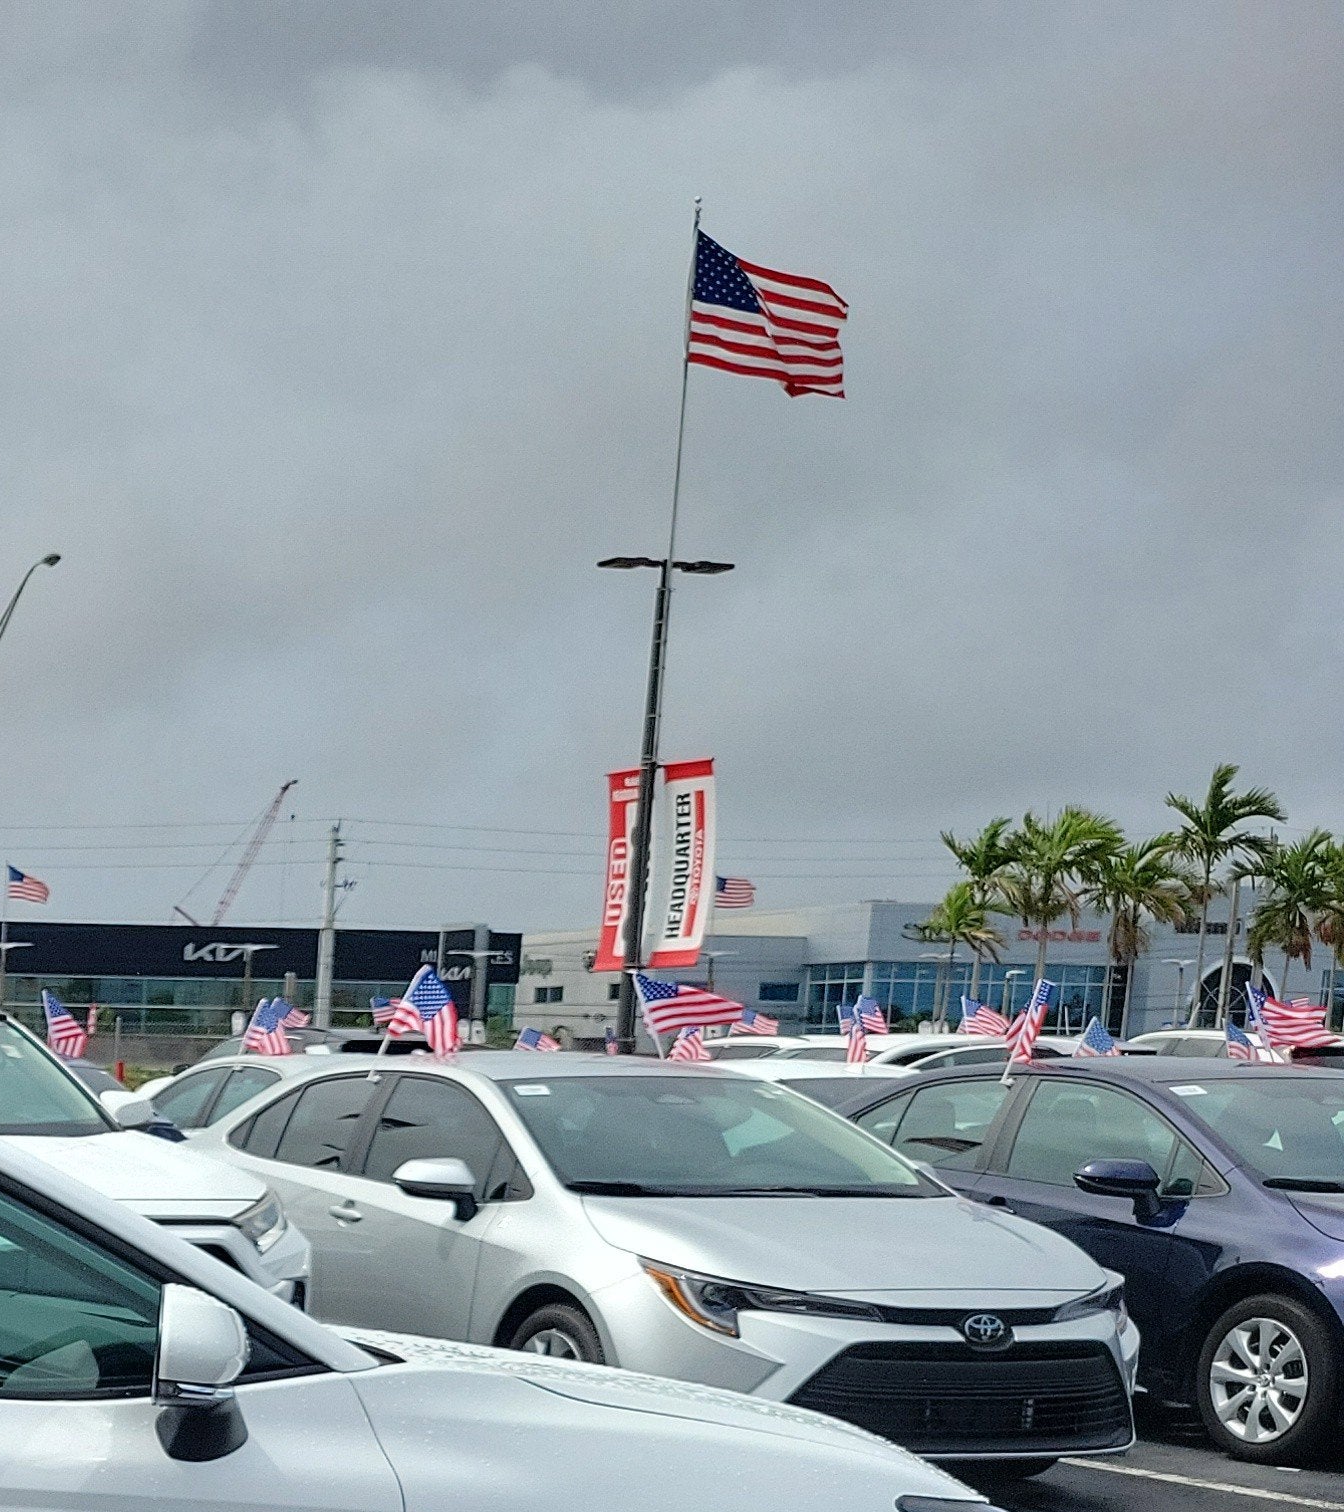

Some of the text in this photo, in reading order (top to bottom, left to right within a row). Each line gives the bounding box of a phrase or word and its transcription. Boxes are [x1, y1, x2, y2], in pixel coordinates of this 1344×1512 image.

[605, 838, 626, 926] USED
[664, 792, 692, 939] HEADQUARTER
[690, 829, 704, 886] TOYOTA
